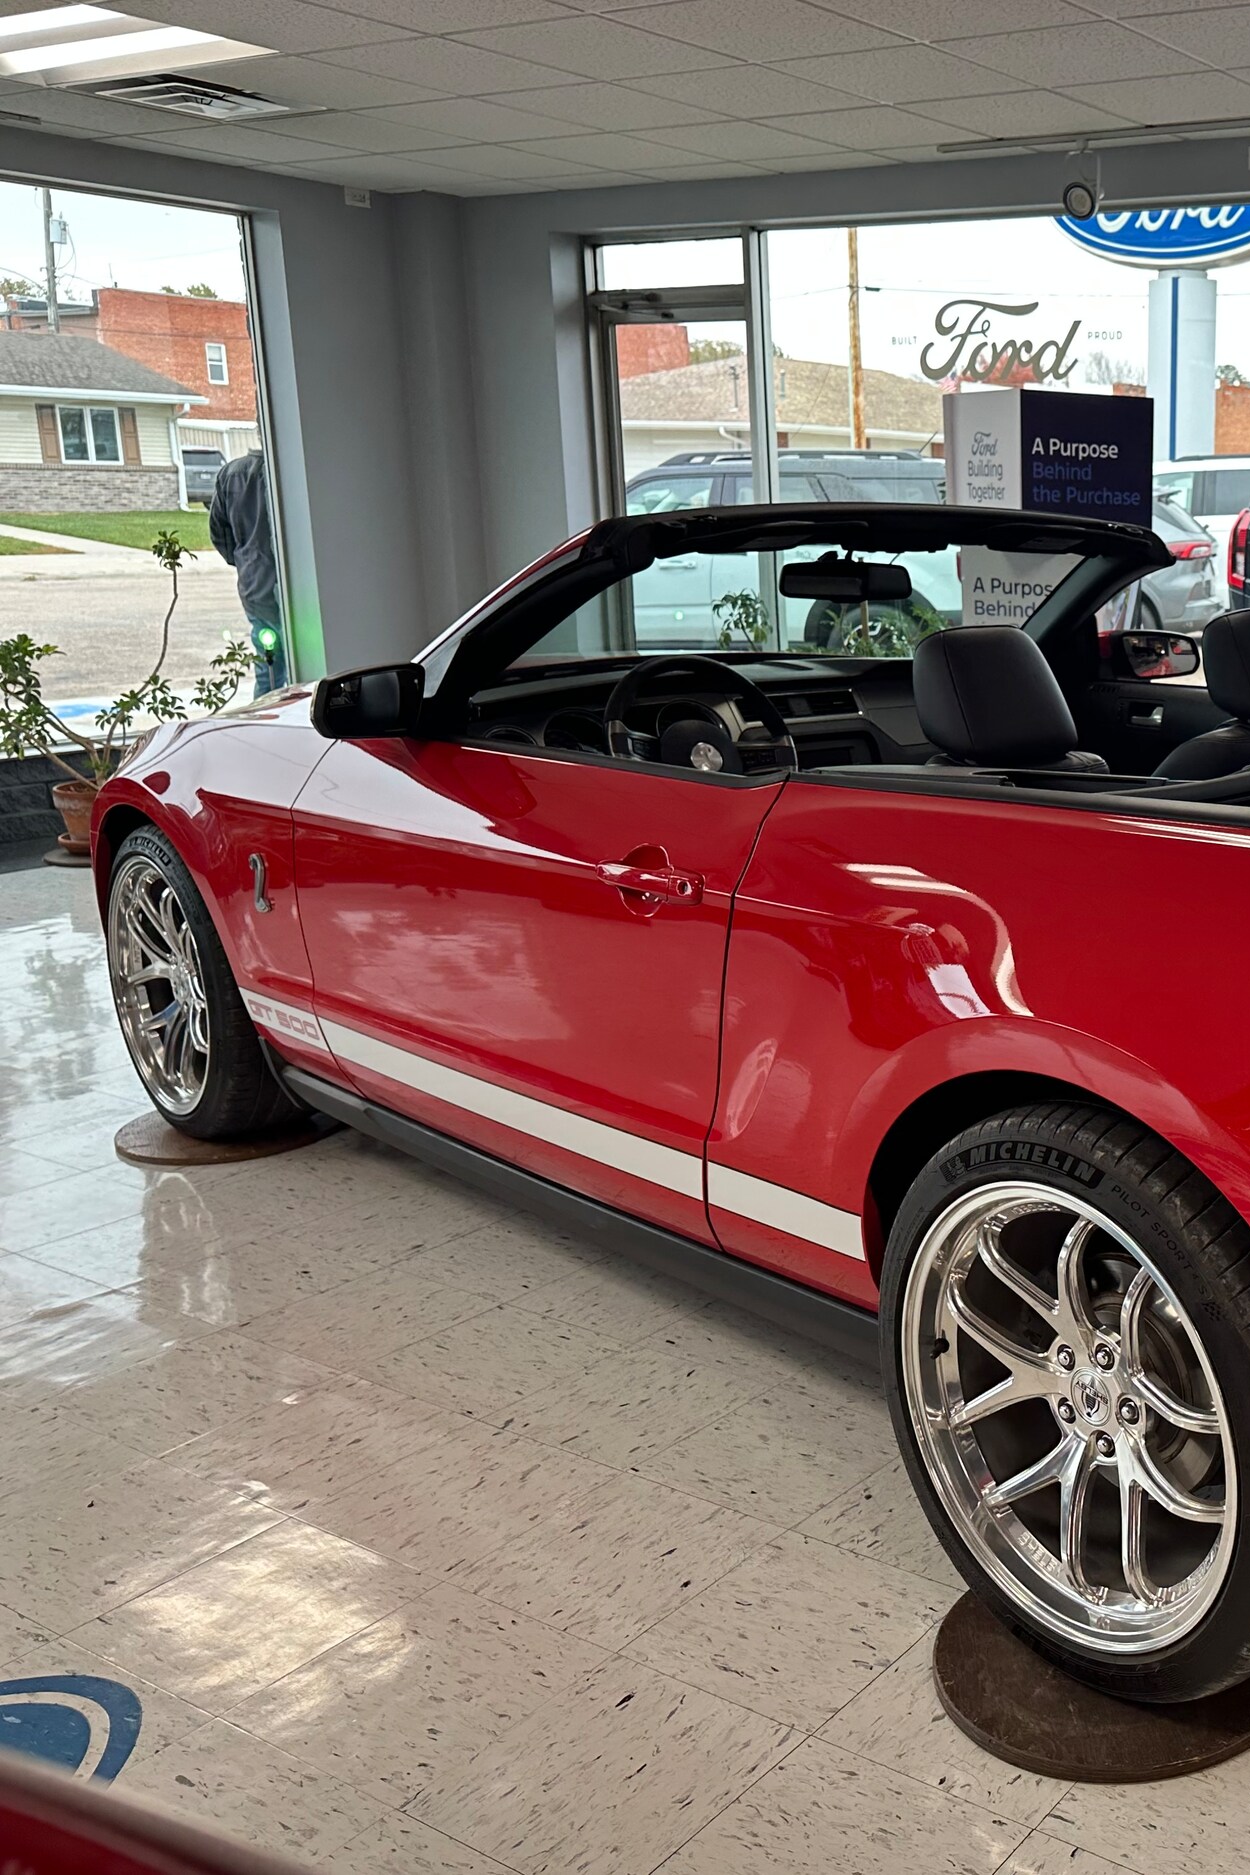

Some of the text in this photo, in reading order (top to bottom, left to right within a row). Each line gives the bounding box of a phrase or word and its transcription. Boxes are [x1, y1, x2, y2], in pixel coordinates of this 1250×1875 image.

[1097, 204, 1245, 233] ord
[891, 299, 1123, 381] BUILT Ford PROUD
[971, 431, 998, 457] Ford
[1032, 437, 1119, 460] A Purpose
[967, 460, 1003, 480] Building
[1032, 462, 1092, 481] Behind
[967, 482, 1005, 503] Together
[1033, 485, 1141, 506] the Purchase
[973, 577, 985, 593] A
[247, 999, 320, 1041] GT 500
[969, 1141, 1097, 1183] MICHELIN
[1111, 1184, 1150, 1219] PILOT
[1151, 1221, 1193, 1271] SPORT
[1075, 1380, 1109, 1405] SHELBY
